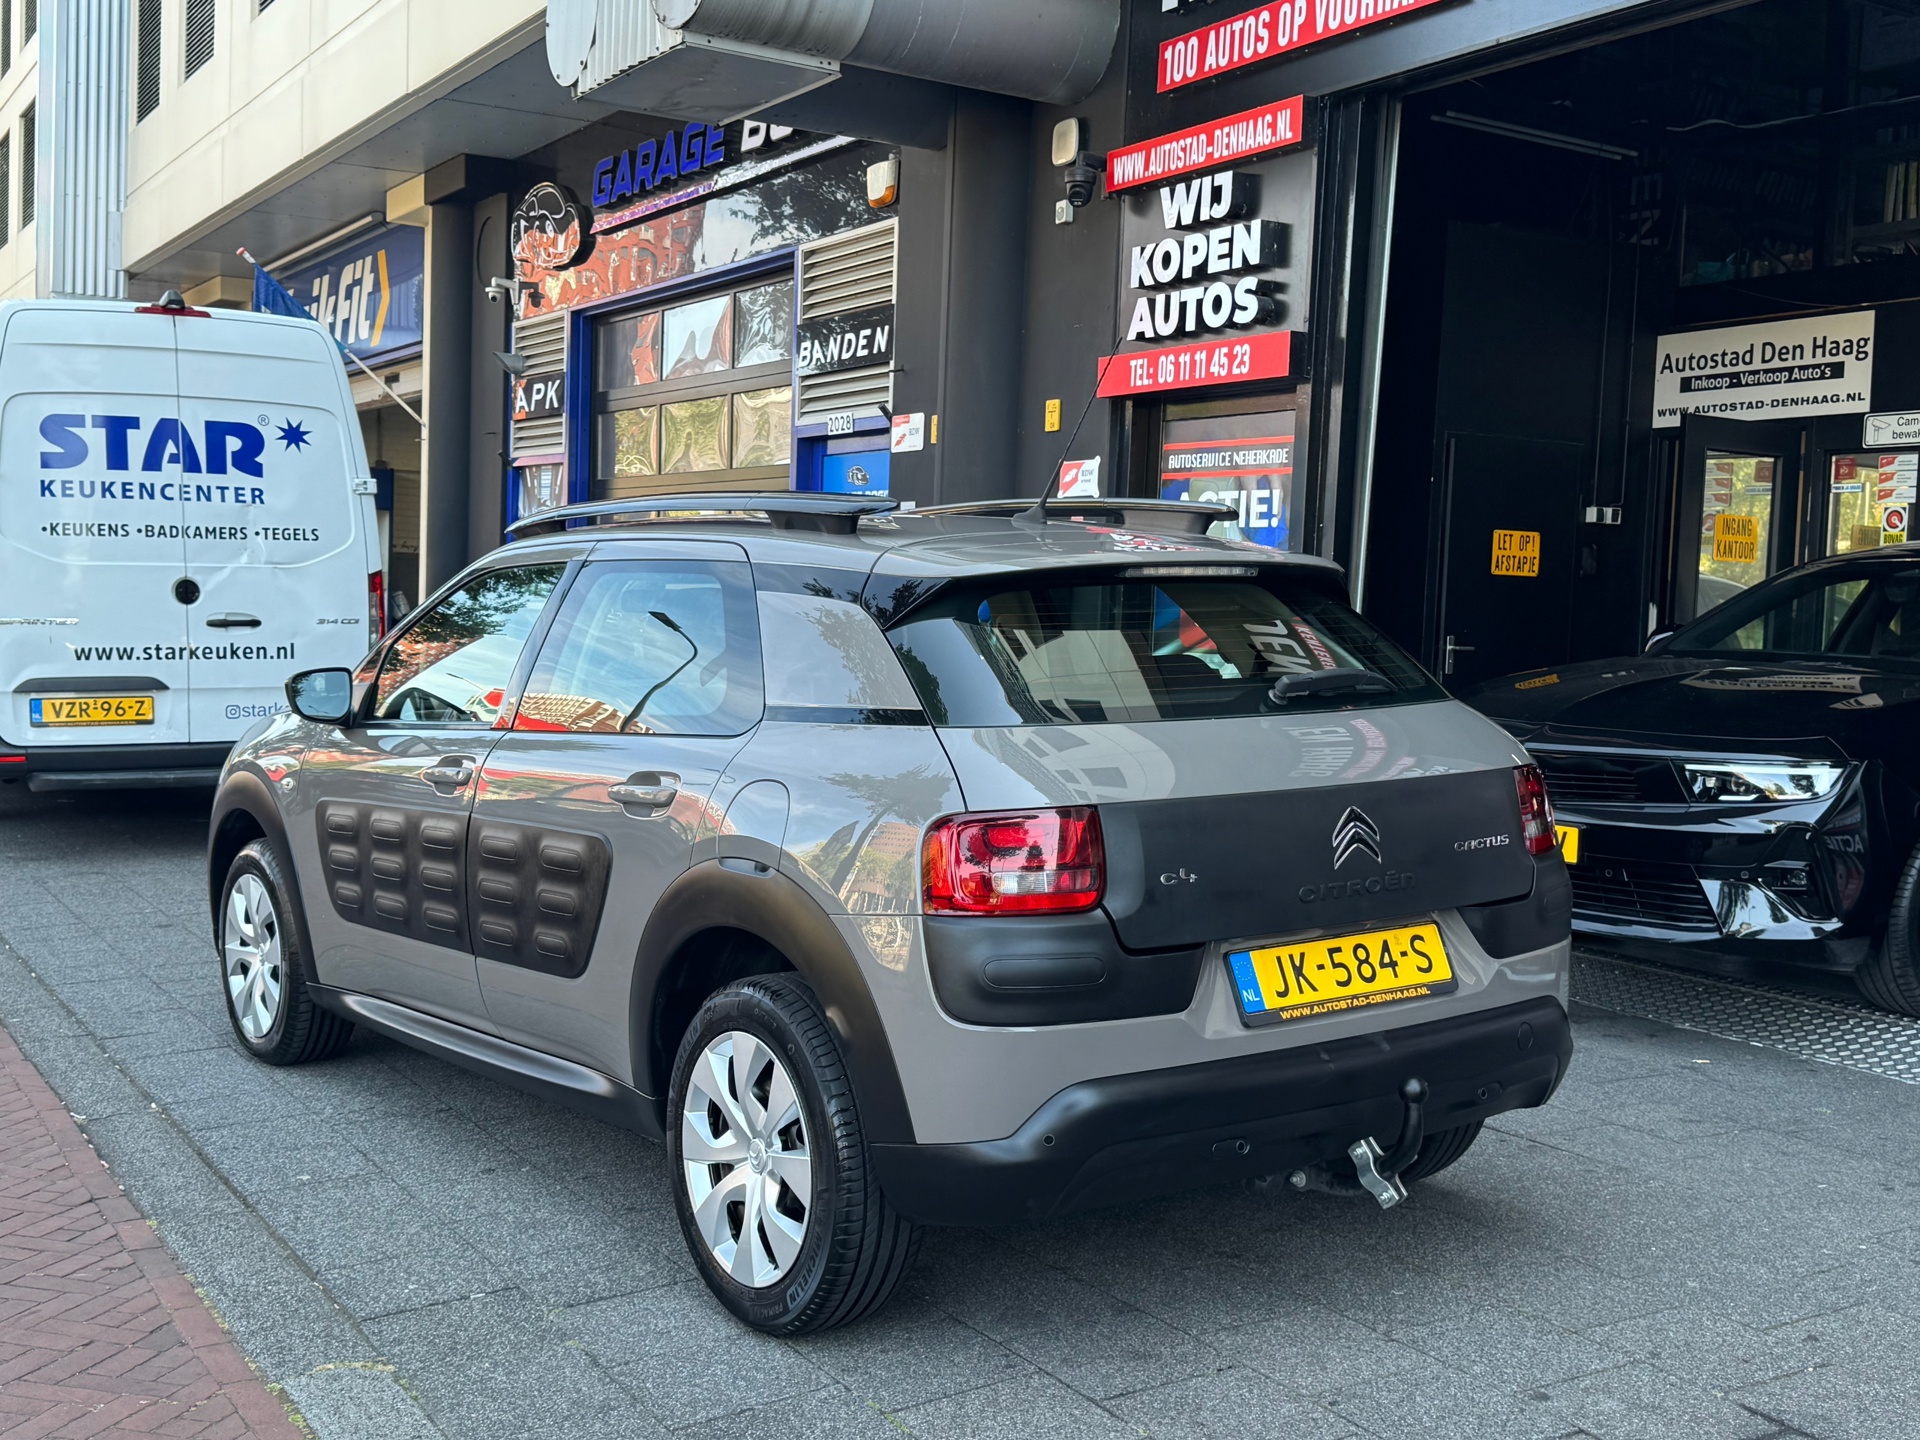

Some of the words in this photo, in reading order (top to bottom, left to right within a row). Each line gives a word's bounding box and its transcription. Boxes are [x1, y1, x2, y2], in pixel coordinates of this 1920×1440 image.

[1164, 36, 1199, 85] 100
[1204, 9, 1270, 72] AUTOS
[1277, 0, 1308, 47] OP
[1113, 108, 1293, 186] WWW.AUTOSTAD-DENHAAG.NL
[591, 121, 725, 208] GARAGE
[1160, 170, 1233, 229] WIJ
[1130, 218, 1261, 288] KOPEN
[1126, 276, 1259, 341] AUTOS
[798, 325, 890, 369] BANDEN
[1660, 343, 1754, 375] Autostad
[1761, 341, 1805, 364] Den
[1811, 335, 1871, 362] Haag
[1130, 358, 1153, 387] TEL:
[1157, 354, 1175, 384] 06
[1178, 352, 1191, 381] 11
[1194, 350, 1207, 379] 11
[1209, 347, 1229, 377] 45
[1232, 343, 1250, 375] 23
[1691, 375, 1729, 391] Inkoop
[1740, 369, 1789, 386] Verkoop
[1791, 365, 1831, 380] Auto's
[515, 378, 561, 413] APK
[1657, 392, 1866, 417] WWW.AUTOSTAD-DENHAAG.NL
[828, 415, 851, 432] 2028
[1168, 451, 1231, 469] AUTOSERVICE
[1233, 448, 1289, 466] NEHERKADE
[39, 479, 266, 505] KEUKENCENTER
[1721, 517, 1753, 537] INGANG
[1883, 533, 1904, 544] BOVAG
[1498, 533, 1514, 551] LET
[1519, 534, 1535, 552] OP!
[1716, 539, 1755, 560] KANTOOR
[1494, 554, 1537, 573] AFSTAPJE
[73, 642, 296, 662] www.starkeuken.nl
[51, 700, 146, 719] VZR-96-Z
[1454, 833, 1510, 852] CACTUS
[1160, 868, 1198, 886] C4
[1274, 934, 1434, 998] JK-584-S
[1242, 988, 1261, 1003] NL
[1279, 987, 1431, 1020] WWW.AUTOSTAD-DENHAAG.NL
